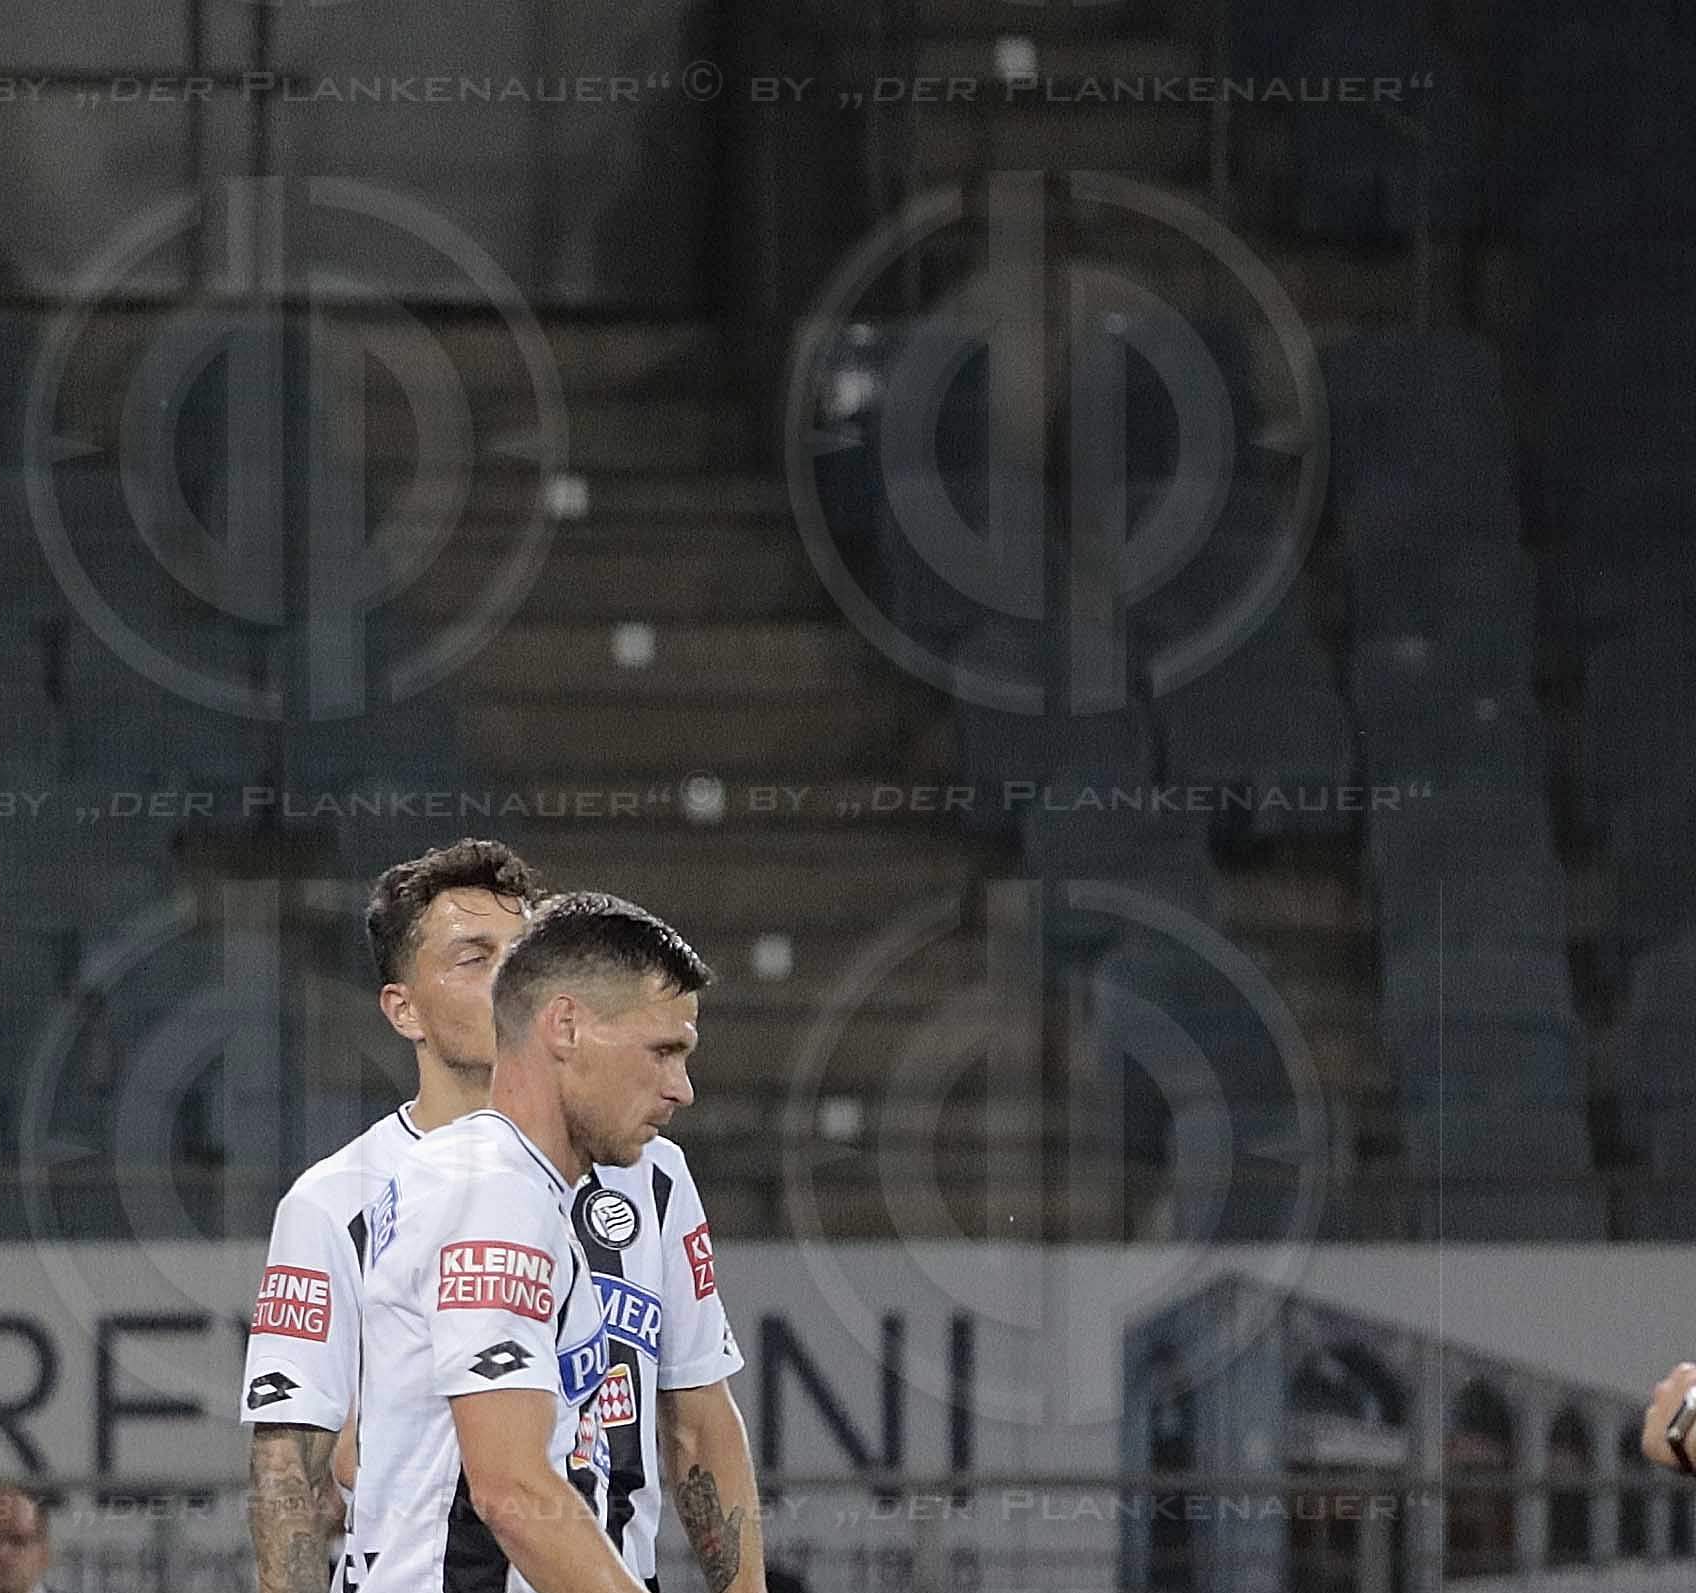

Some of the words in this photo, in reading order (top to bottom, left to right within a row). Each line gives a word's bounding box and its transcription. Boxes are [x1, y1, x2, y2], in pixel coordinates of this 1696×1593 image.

[444, 1247, 552, 1284] KLEINE
[258, 1273, 329, 1306] LEINE
[439, 1276, 552, 1315] ZEITUNG
